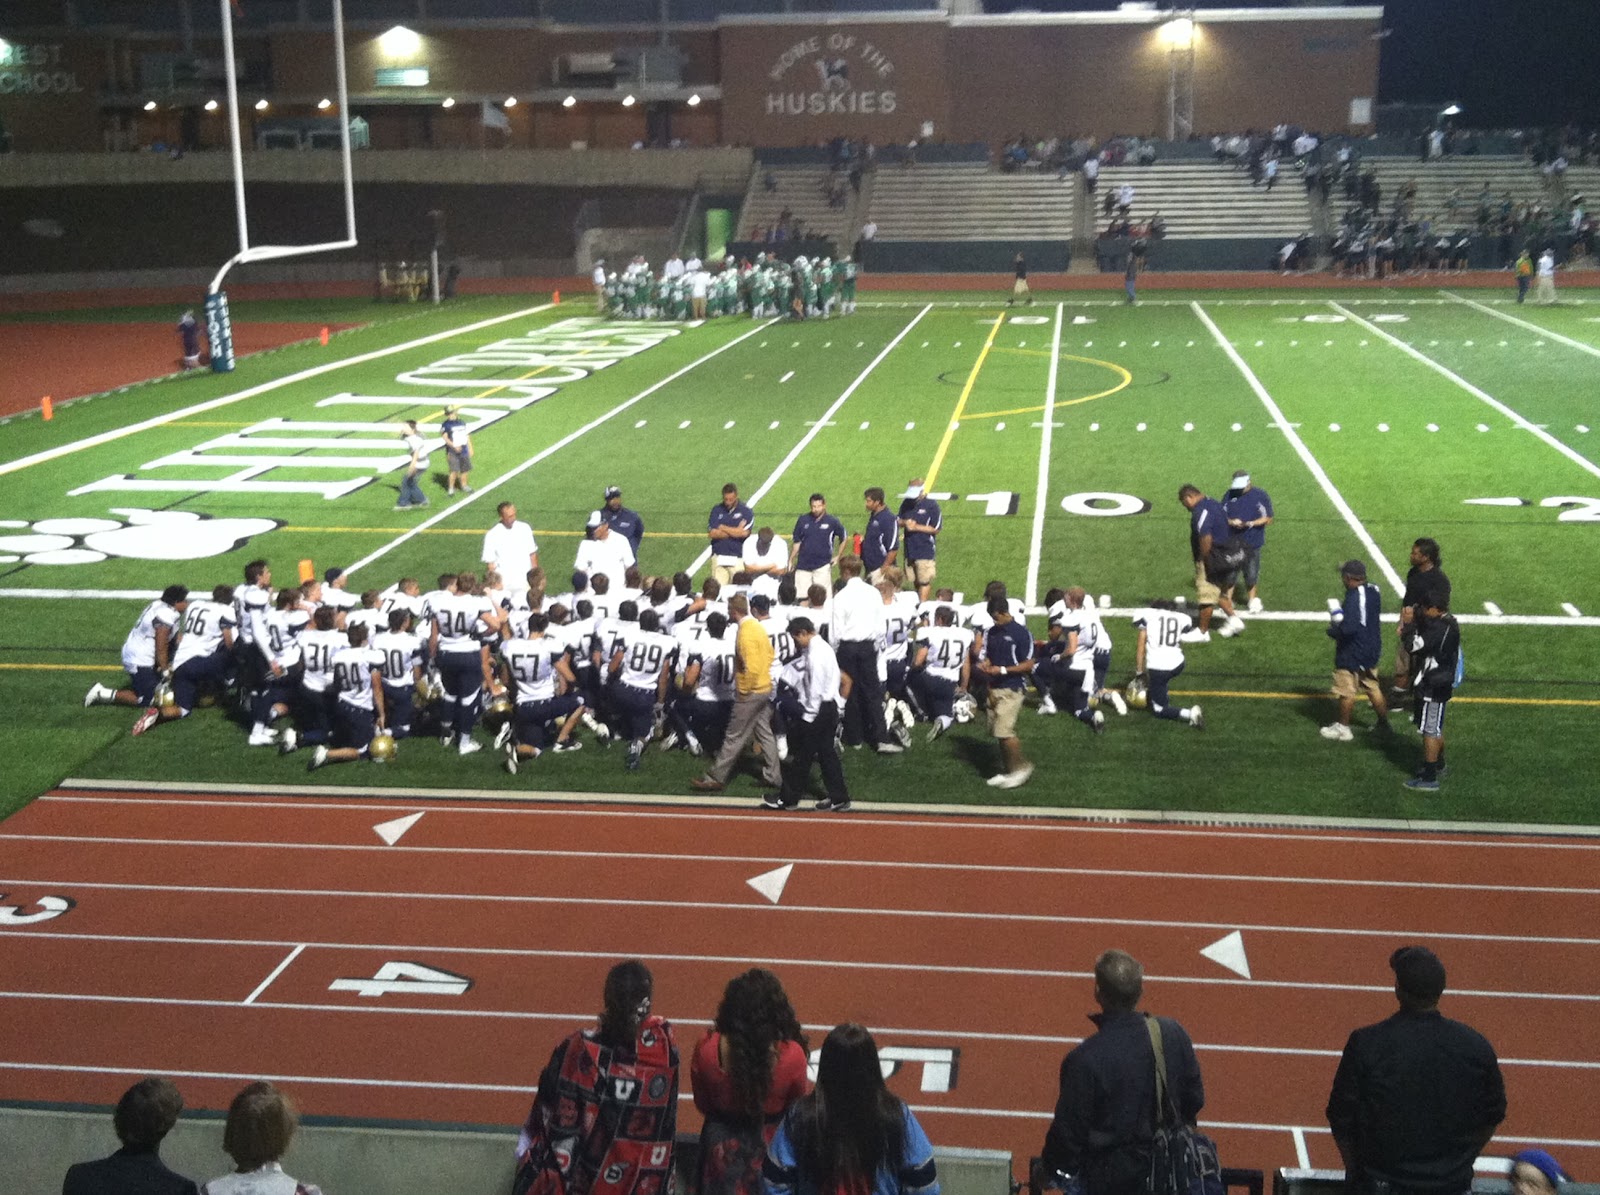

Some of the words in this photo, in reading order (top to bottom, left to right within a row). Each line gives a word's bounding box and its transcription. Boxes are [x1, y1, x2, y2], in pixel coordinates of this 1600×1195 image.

[769, 35, 821, 80] HOME
[827, 32, 857, 50] OF
[861, 40, 896, 79] THE
[765, 90, 898, 115] HUSKIES
[185, 606, 210, 636] 66
[440, 609, 468, 638] 34
[1158, 616, 1179, 647] 18
[308, 642, 332, 675] 31
[511, 653, 540, 682] 57
[630, 641, 663, 674] 89
[938, 639, 964, 669] 43
[329, 961, 473, 997] 4
[614, 1079, 636, 1102] U
